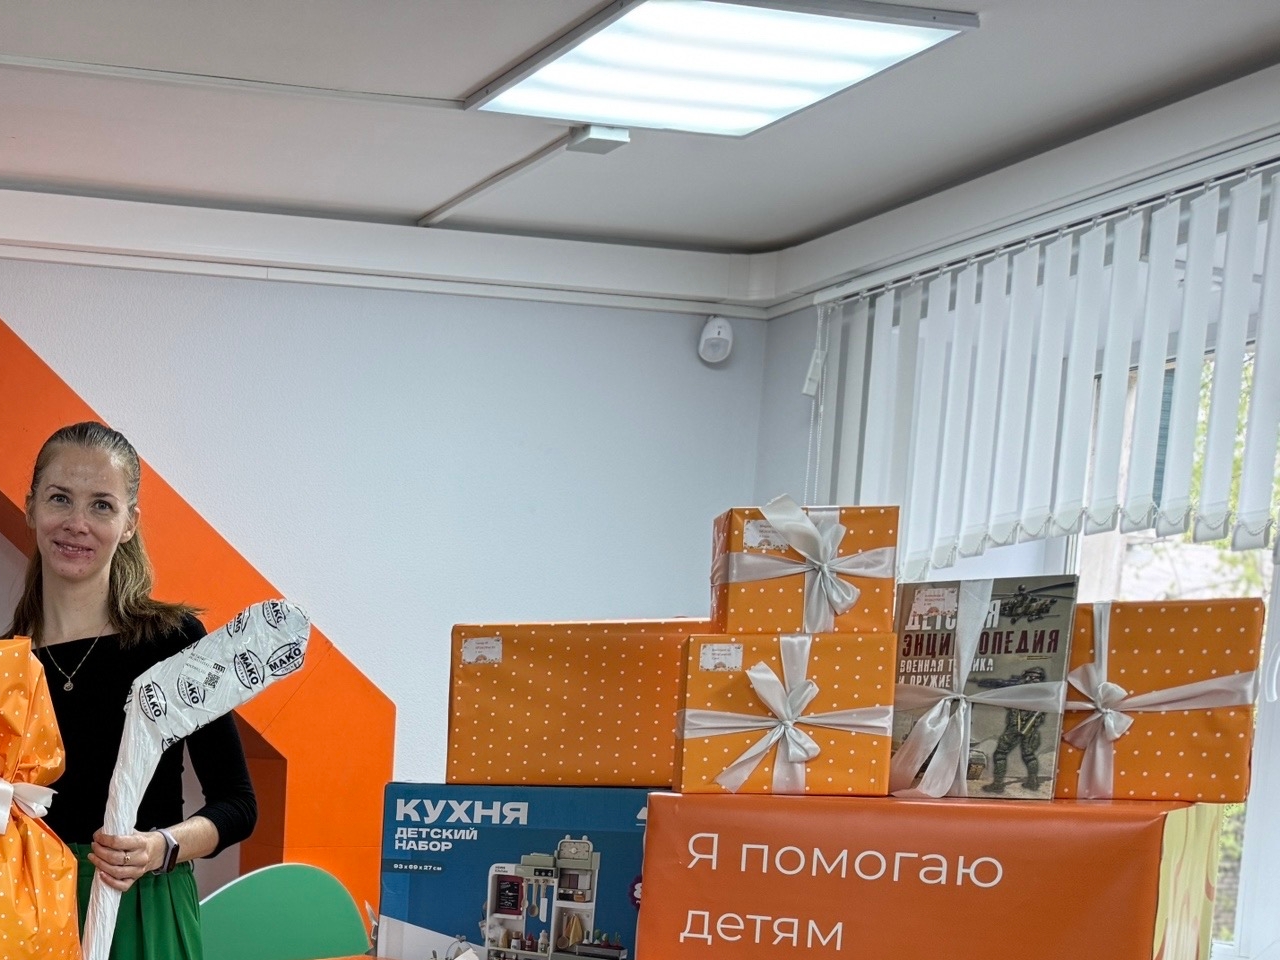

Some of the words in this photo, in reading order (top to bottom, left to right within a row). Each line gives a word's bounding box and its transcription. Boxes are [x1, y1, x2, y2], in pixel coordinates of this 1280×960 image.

[902, 629, 1060, 659] ЭНЦИОПЕДИЯ
[239, 651, 260, 686] MAKO
[268, 647, 303, 672] MAKO
[899, 658, 944, 673] ВОЕННАЯ
[948, 657, 994, 672] ТИКА
[910, 674, 952, 688] ОРУЖИЕ
[143, 682, 162, 718] MAKO
[395, 799, 529, 825] КУХНЯ
[394, 826, 478, 840] ДЕТСКИЙ
[394, 839, 453, 852] НАБОР
[687, 833, 719, 870] Я
[740, 843, 1003, 888] помогаю
[679, 910, 843, 951] детям
